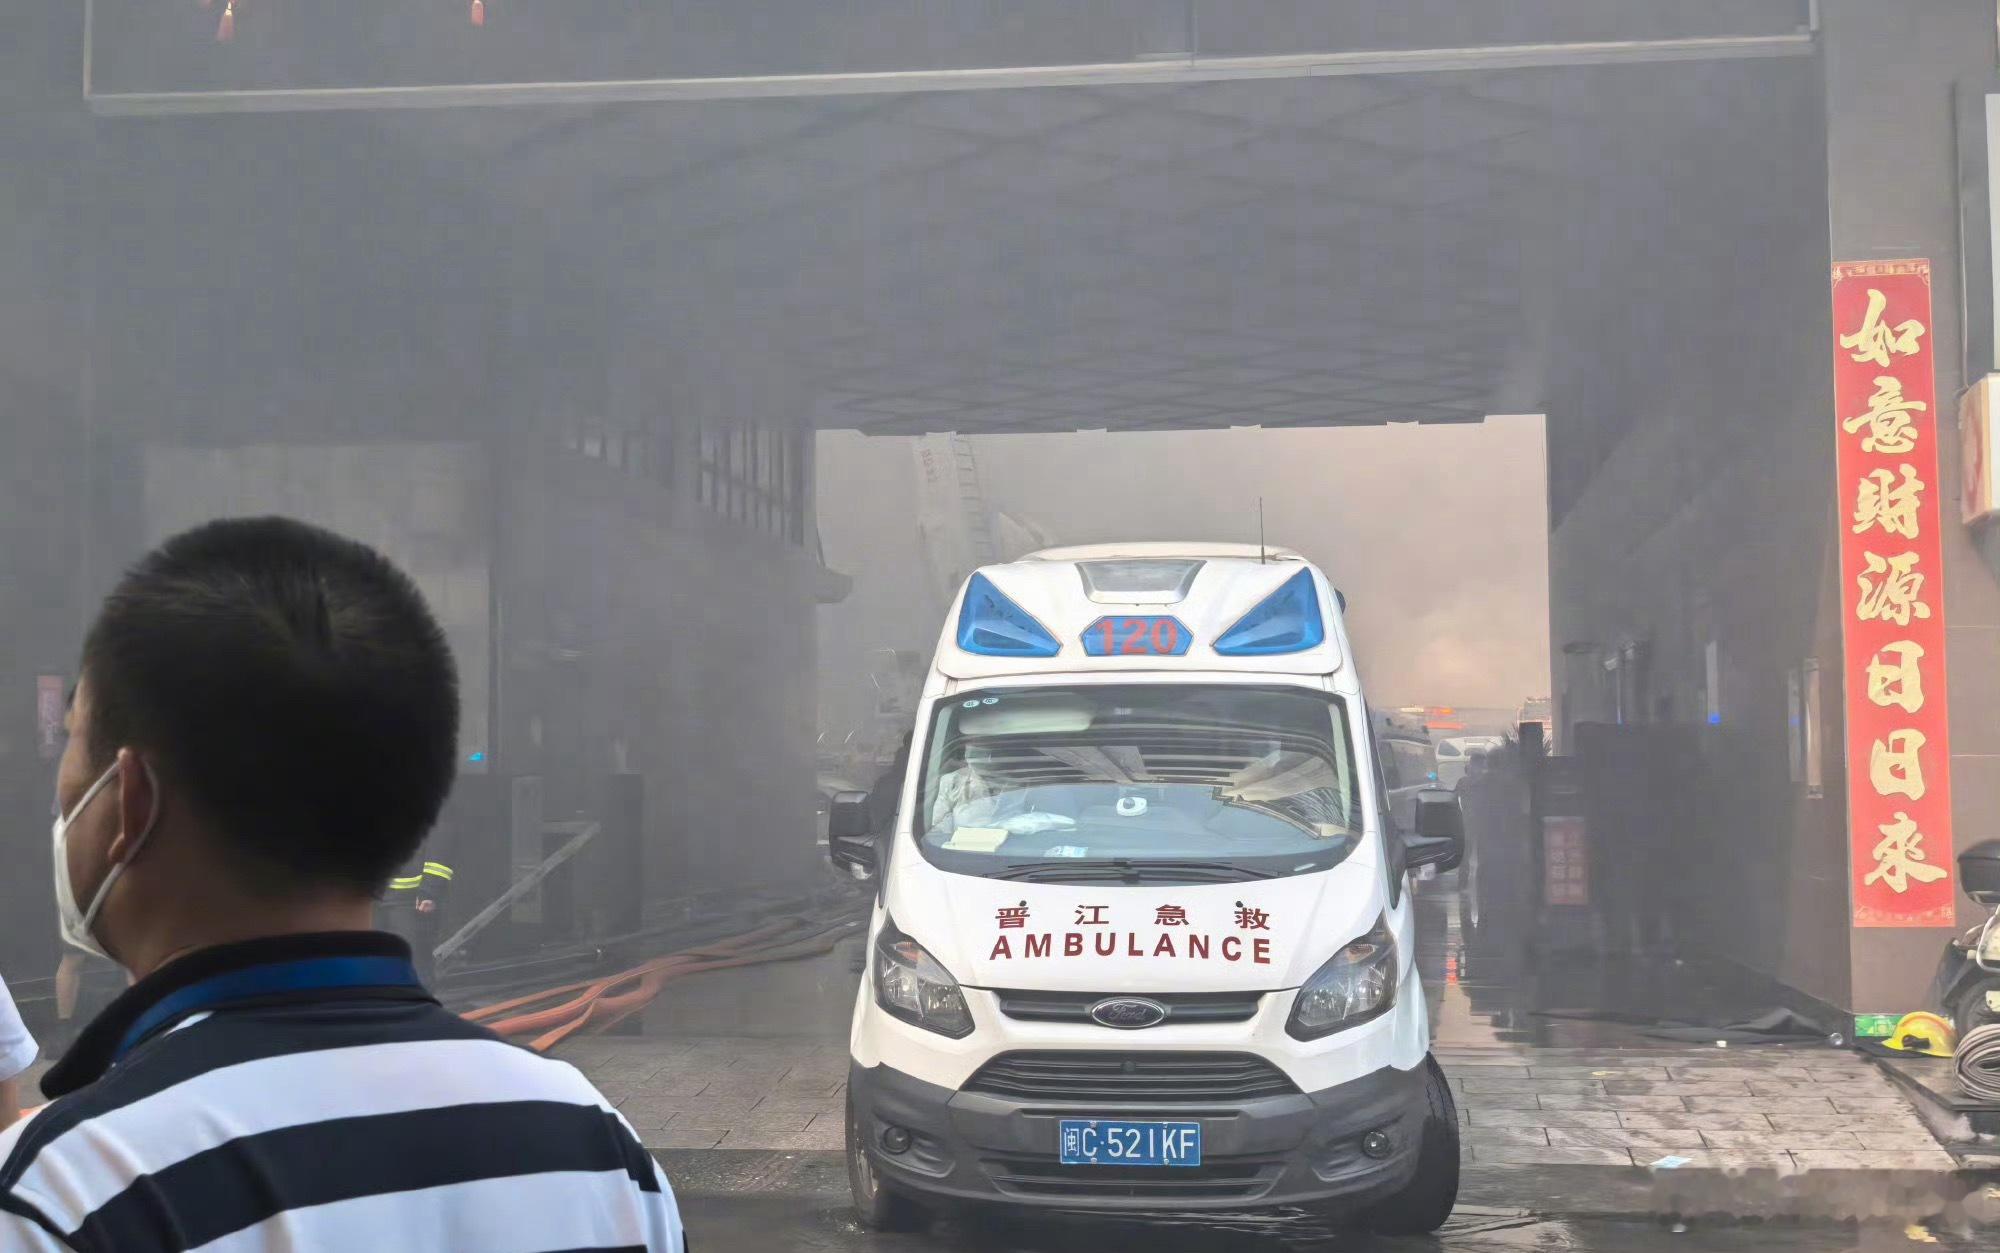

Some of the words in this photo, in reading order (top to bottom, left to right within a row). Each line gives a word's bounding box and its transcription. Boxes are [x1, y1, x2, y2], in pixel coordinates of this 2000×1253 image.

[1097, 618, 1178, 655] 120
[989, 932, 1271, 964] AMBULANCE
[1109, 1003, 1147, 1020] Ford
